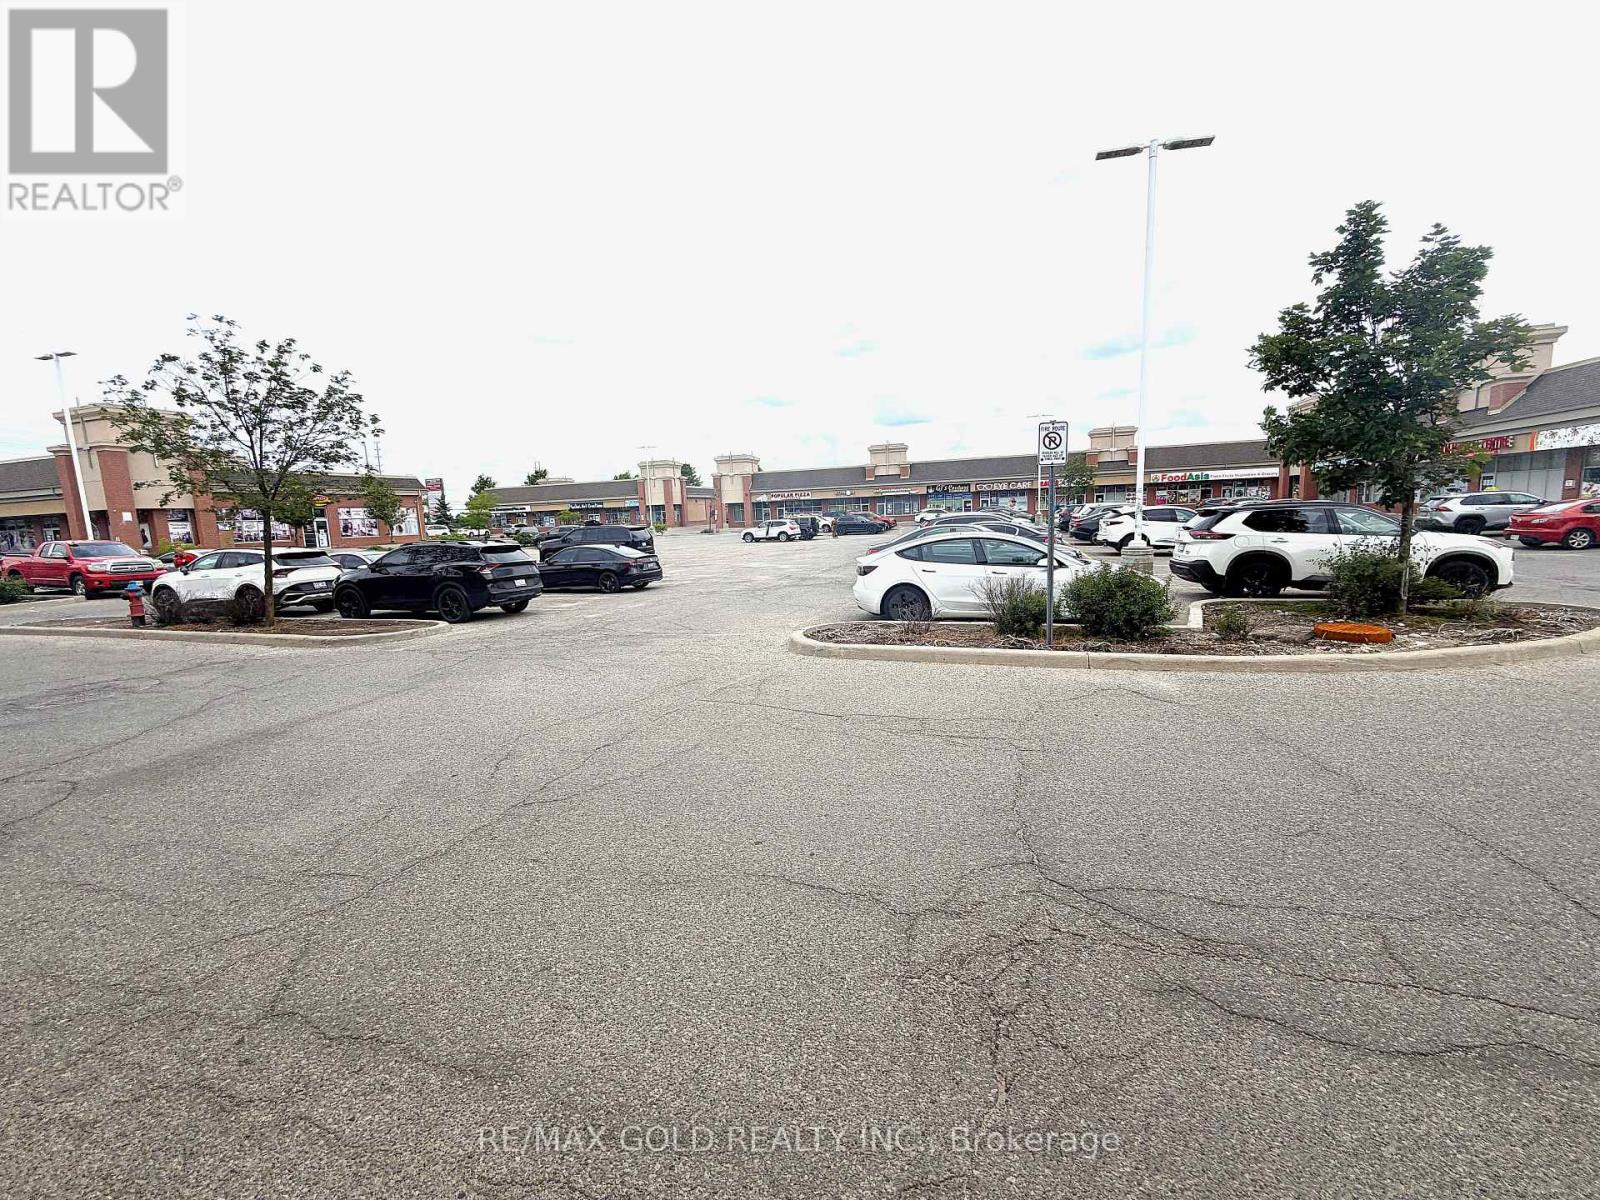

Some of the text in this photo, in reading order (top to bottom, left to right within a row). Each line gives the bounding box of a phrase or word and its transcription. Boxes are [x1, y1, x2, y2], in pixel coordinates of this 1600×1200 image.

[1161, 472, 1210, 482] FoodAsia
[994, 482, 1009, 490] EYE
[1009, 481, 1032, 489] CARE
